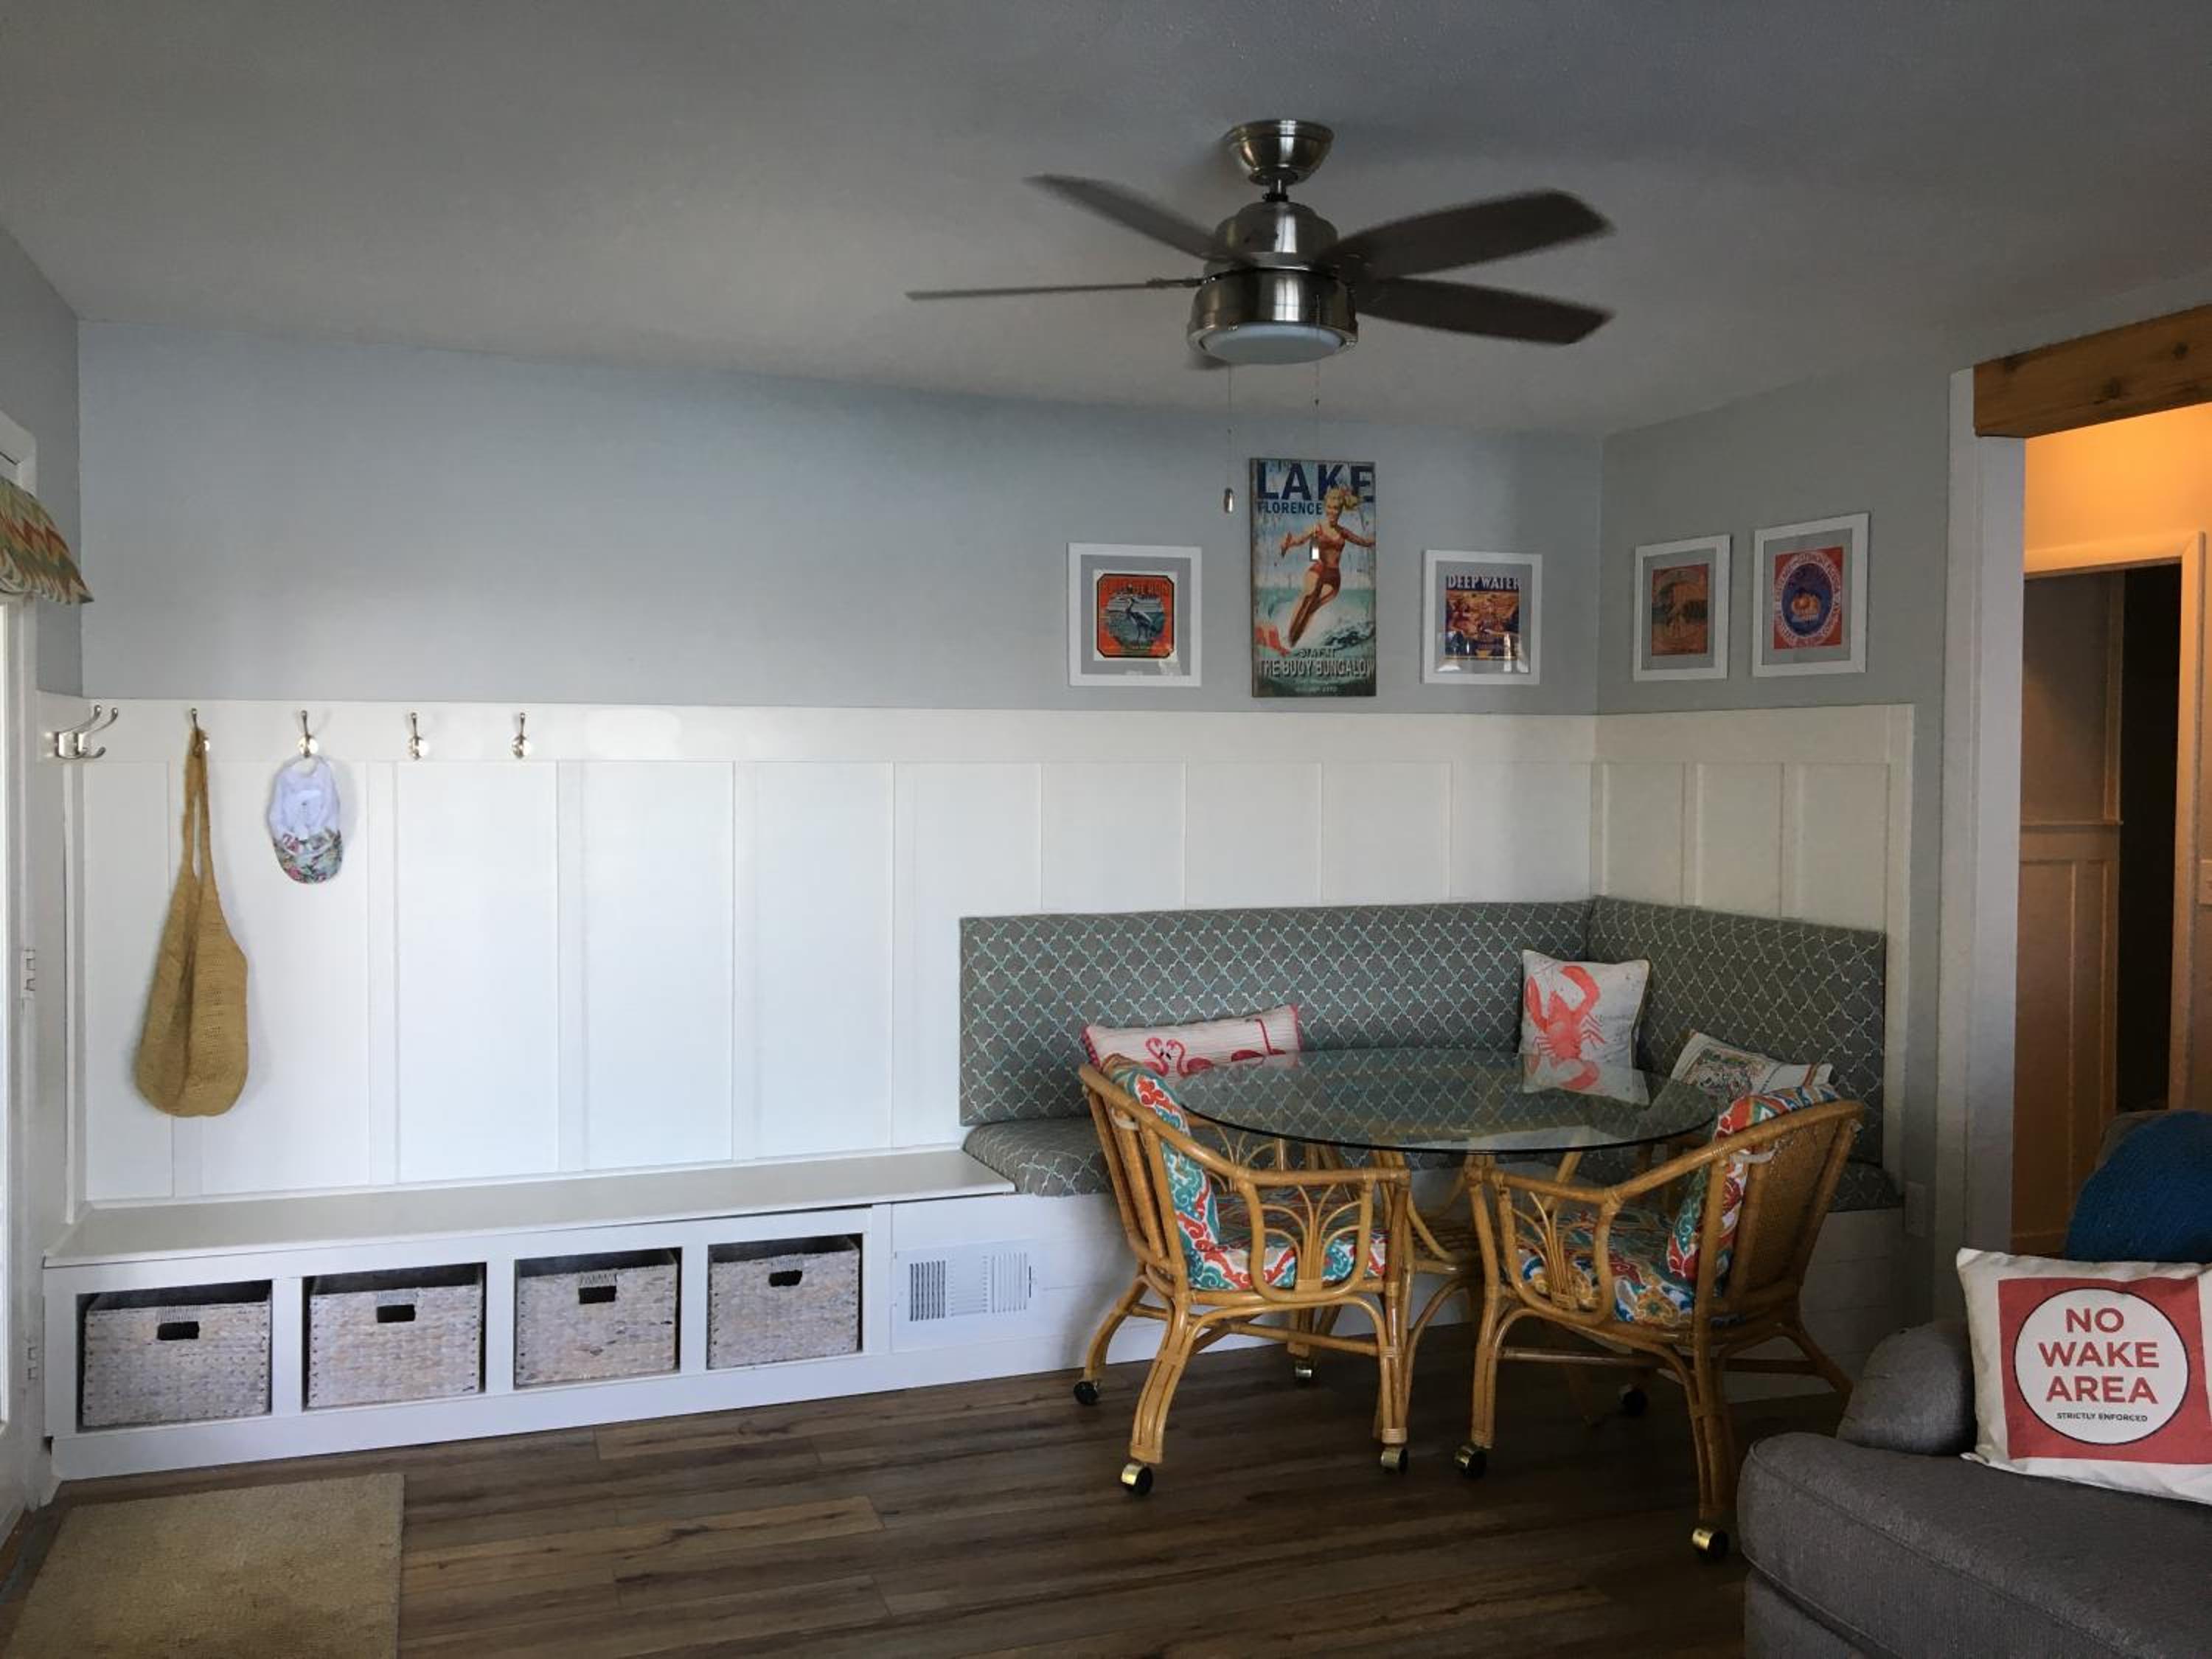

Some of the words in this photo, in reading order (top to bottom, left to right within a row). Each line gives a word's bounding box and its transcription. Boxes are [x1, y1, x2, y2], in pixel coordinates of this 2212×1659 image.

[1257, 461, 1375, 502] LAKE
[1256, 501, 1322, 515] FLORENCE
[1447, 574, 1479, 589] DEEP
[1481, 577, 1521, 591] WATER
[1258, 660, 1281, 677] THE
[1283, 659, 1312, 677] BUOY
[1316, 658, 1375, 677] BUNGALOW
[2066, 1307, 2124, 1333] NO
[2038, 1341, 2160, 1368] WAKE
[2045, 1375, 2158, 1404] AREA
[2056, 1412, 2096, 1420] STRICTLY
[2098, 1413, 2148, 1422] ENFORCED
